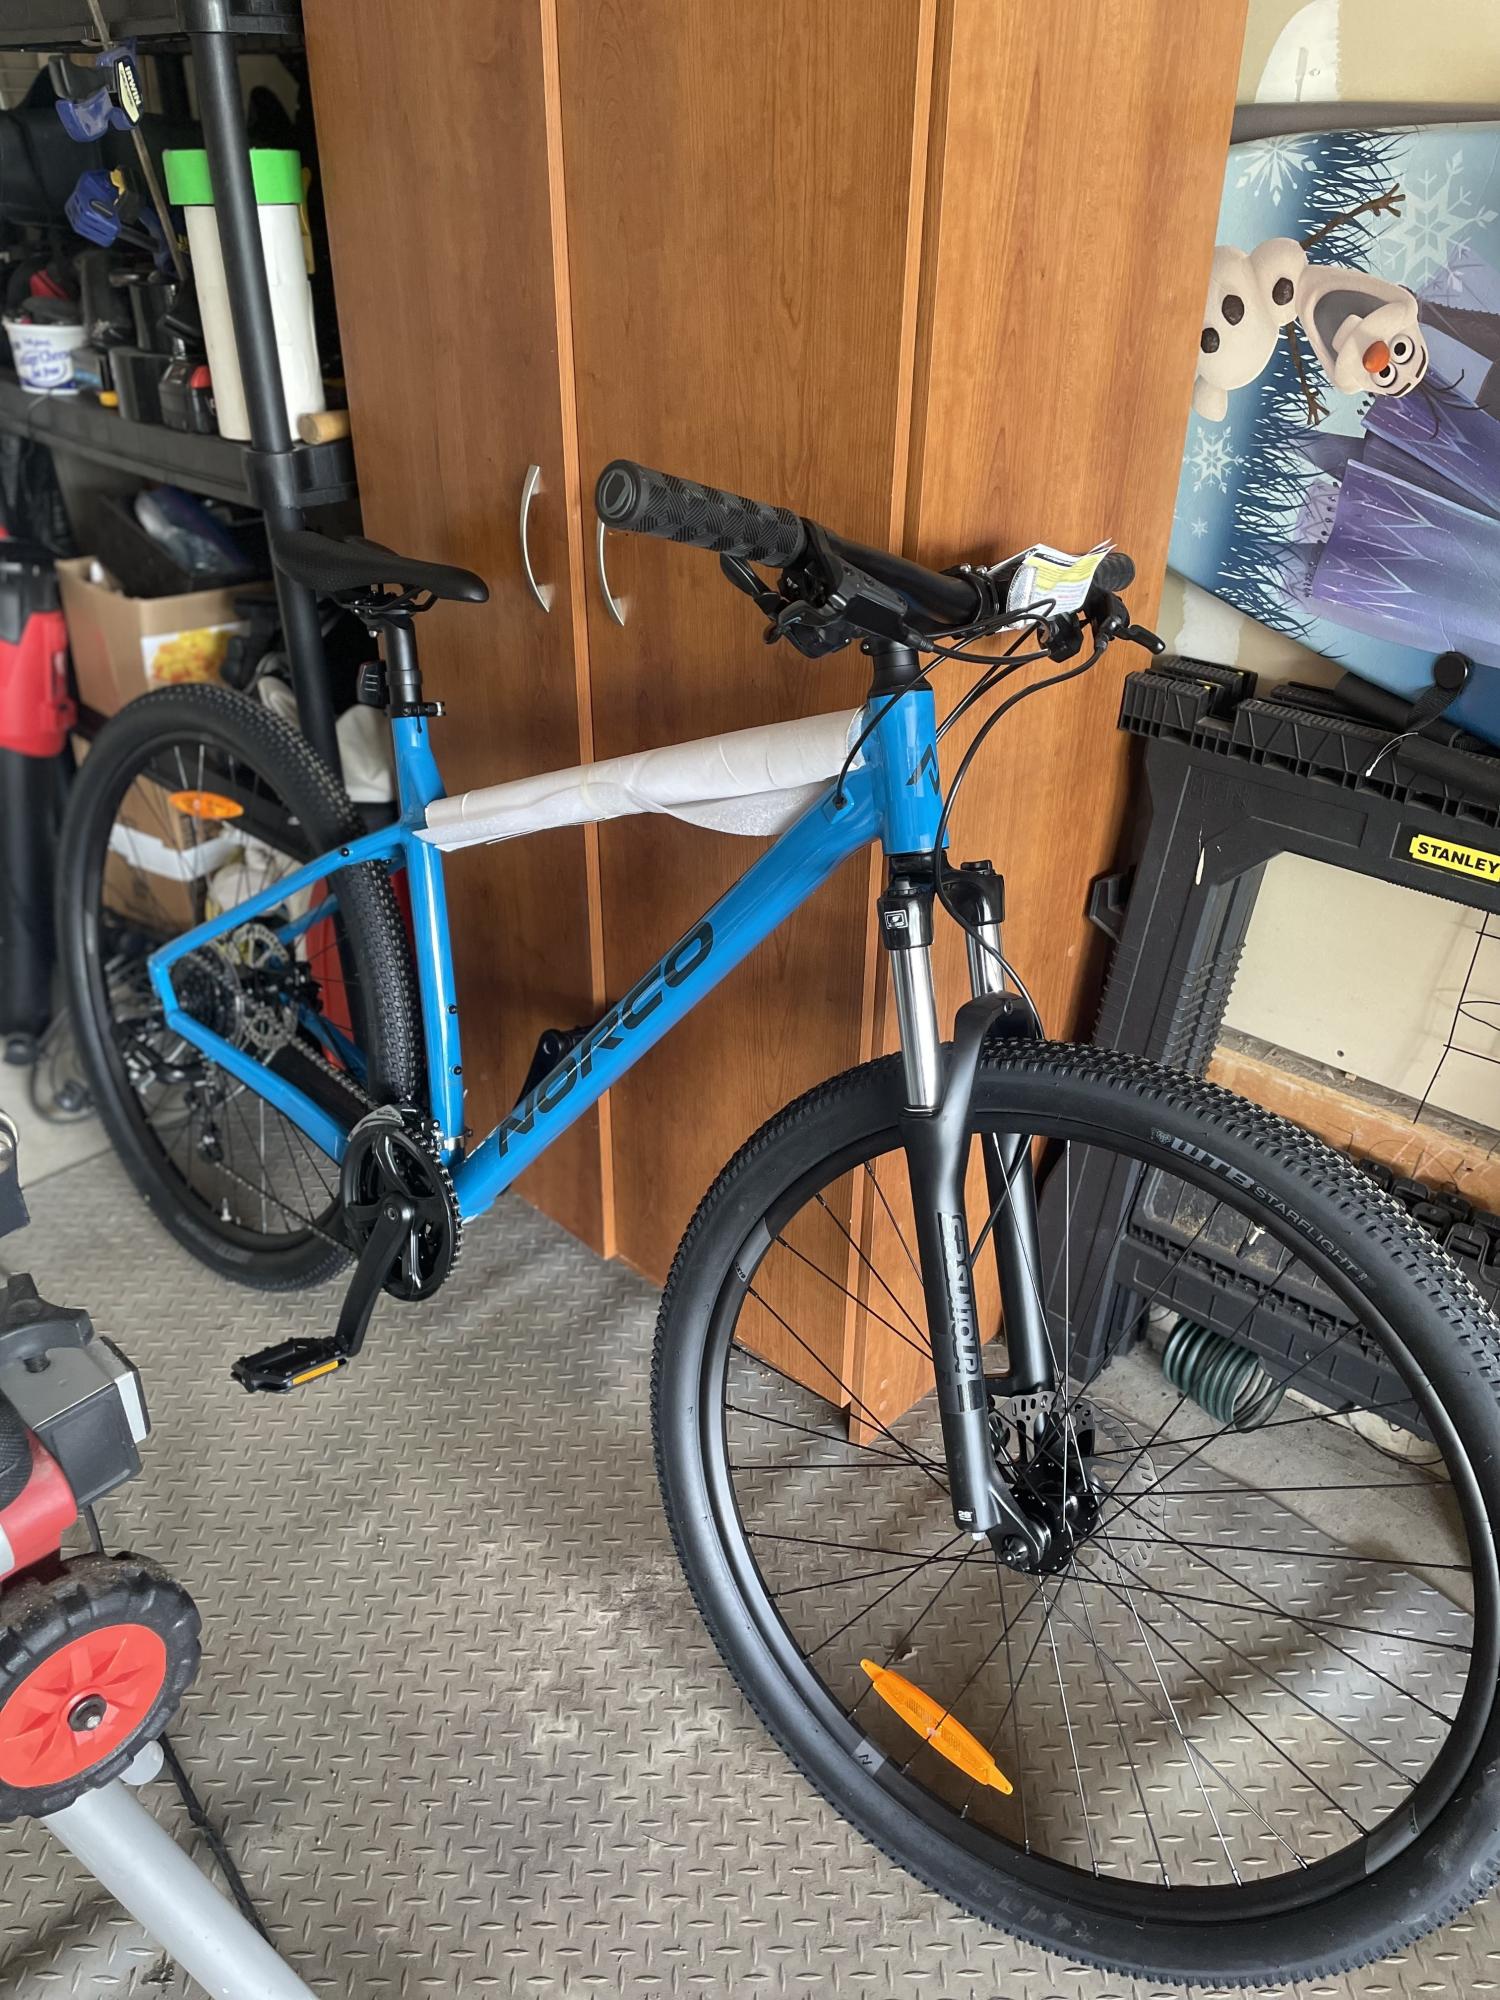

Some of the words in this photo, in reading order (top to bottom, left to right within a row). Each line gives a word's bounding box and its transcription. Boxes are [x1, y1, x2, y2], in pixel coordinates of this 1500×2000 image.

[124, 65, 141, 105] IRWIN
[1417, 841, 1500, 874] STANLEY
[499, 920, 714, 1158] NORCO
[1170, 1137, 1255, 1189] WTB
[1253, 1185, 1360, 1277] STARFLIGHT
[944, 1261, 979, 1375] SUNTOUR
